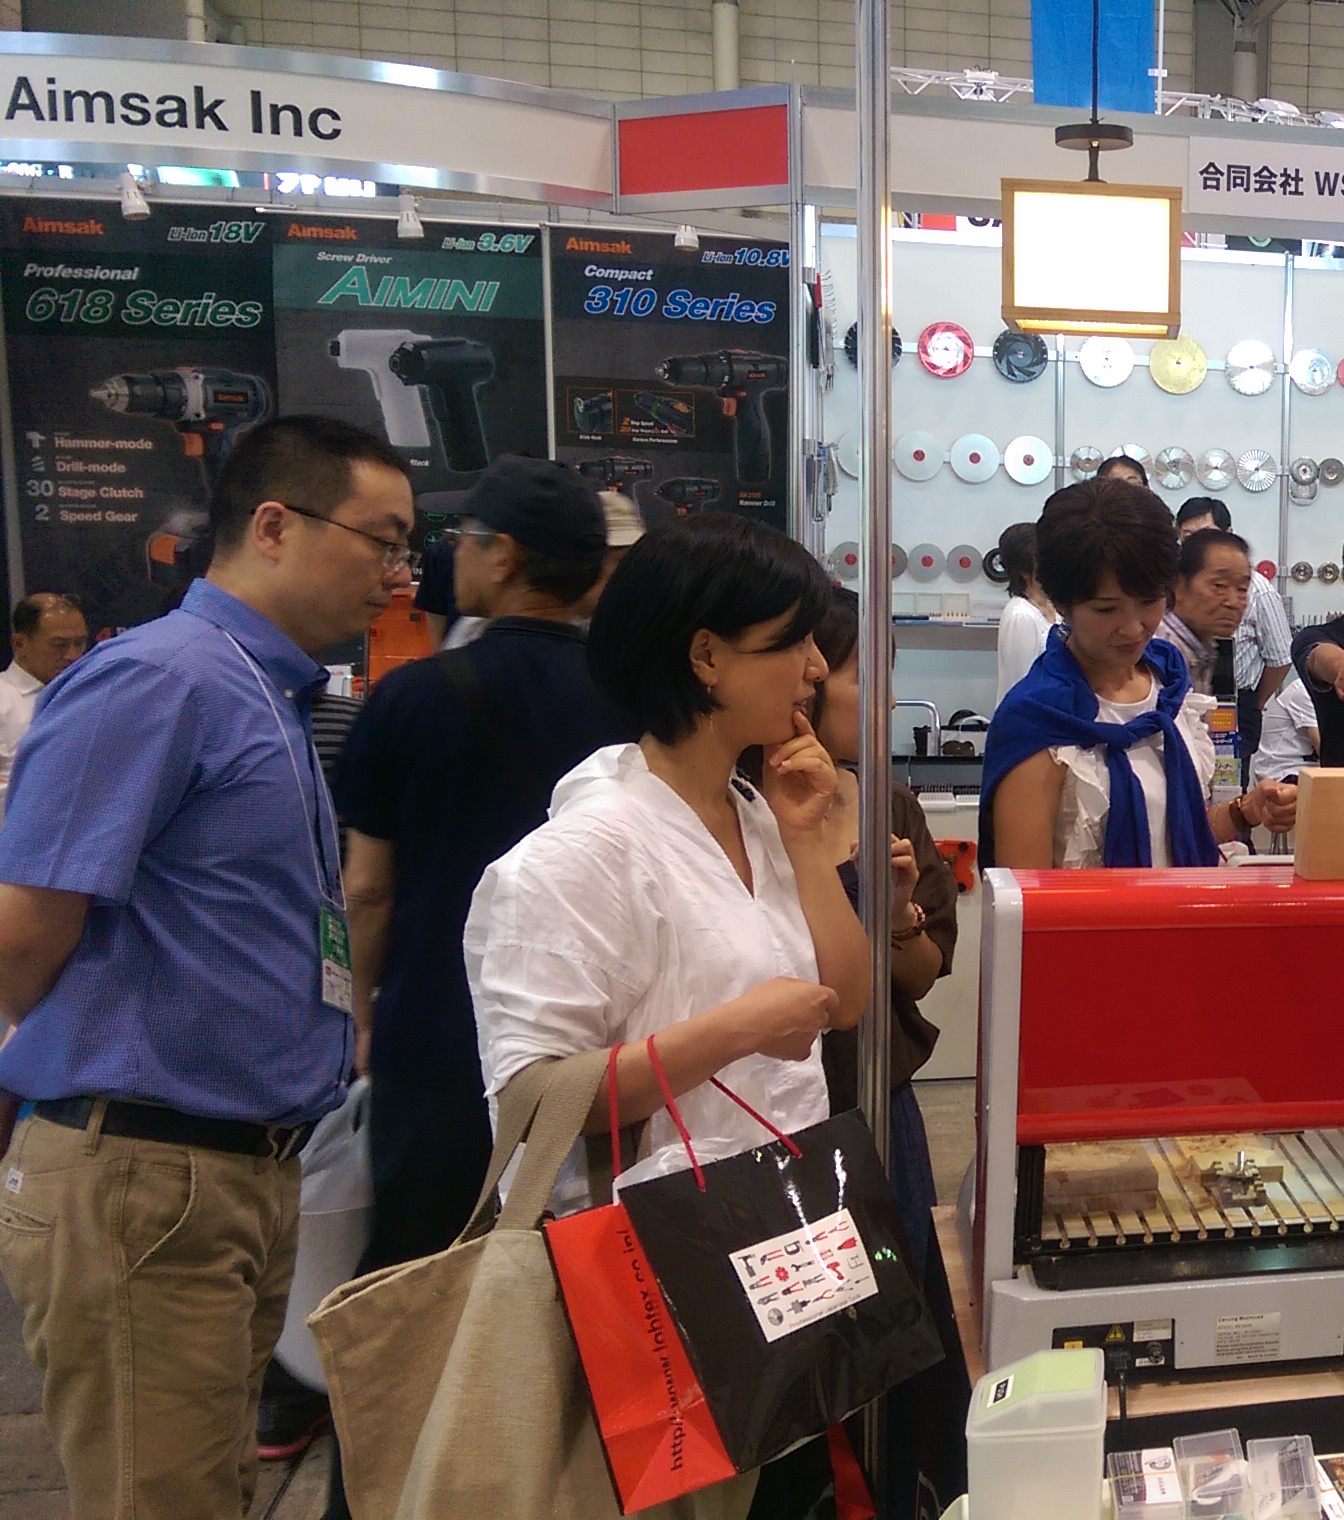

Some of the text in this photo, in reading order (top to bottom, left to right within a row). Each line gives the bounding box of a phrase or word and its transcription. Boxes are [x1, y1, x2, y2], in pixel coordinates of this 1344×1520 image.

[4, 75, 343, 141] Aimsak Inc
[1198, 161, 1304, 197] 合同会社
[23, 217, 103, 235] Aimsak
[209, 221, 265, 243] 18V
[288, 223, 357, 240] Aimsak
[477, 233, 534, 254] 3.6V
[566, 237, 632, 254] Aimsak
[317, 251, 393, 265] Screw Driver
[24, 263, 140, 281] Professional
[584, 264, 654, 281] Compact
[26, 287, 263, 328] 618 Series
[584, 285, 776, 323] 310 Series
[54, 437, 153, 450] Hammer-mode
[56, 461, 127, 474] Drill-mode
[26, 480, 143, 500] 30 Stage Clutch
[35, 503, 138, 524] 2 Speed Gear
